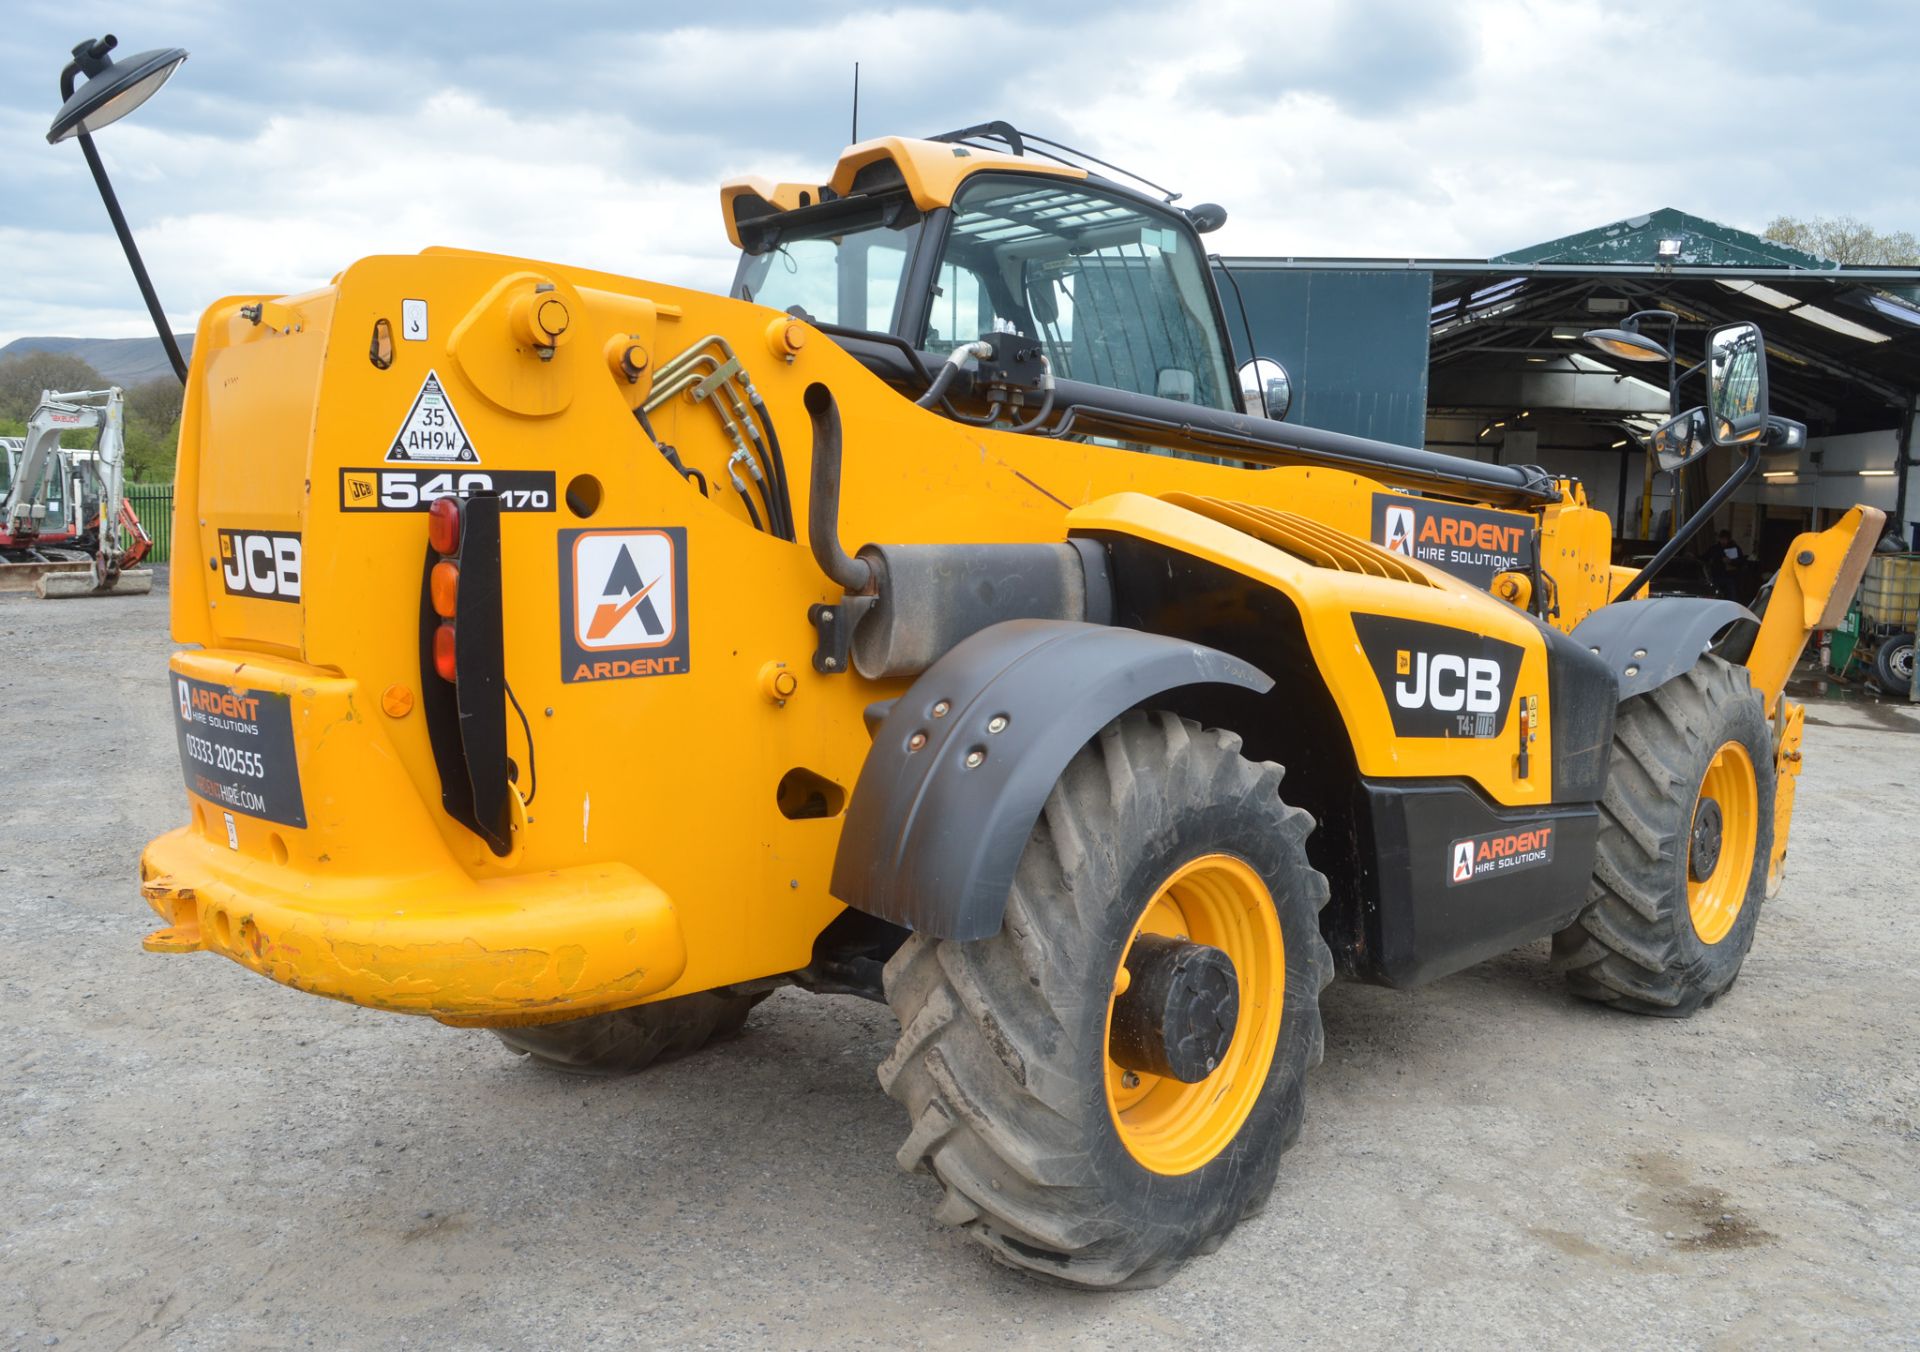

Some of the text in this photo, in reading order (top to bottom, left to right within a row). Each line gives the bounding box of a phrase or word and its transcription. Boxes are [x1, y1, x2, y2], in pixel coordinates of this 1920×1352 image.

[422, 408, 444, 427] 35
[408, 430, 456, 450] AH9W
[352, 481, 373, 500] JCB
[500, 490, 549, 508] 170
[1419, 515, 1524, 553] ARDENT
[224, 534, 302, 598] JCB
[1417, 546, 1518, 568] HIRE SOLUTIONS
[573, 656, 680, 681] ARDENT
[1395, 651, 1501, 713] JCB
[192, 688, 259, 721] ARDENT
[192, 712, 259, 736] HIRE SOLUTIONS
[186, 733, 265, 778] 03333 202555
[1476, 828, 1552, 861] ARDENT
[1475, 850, 1546, 874] HIRE SOLUTIONS
